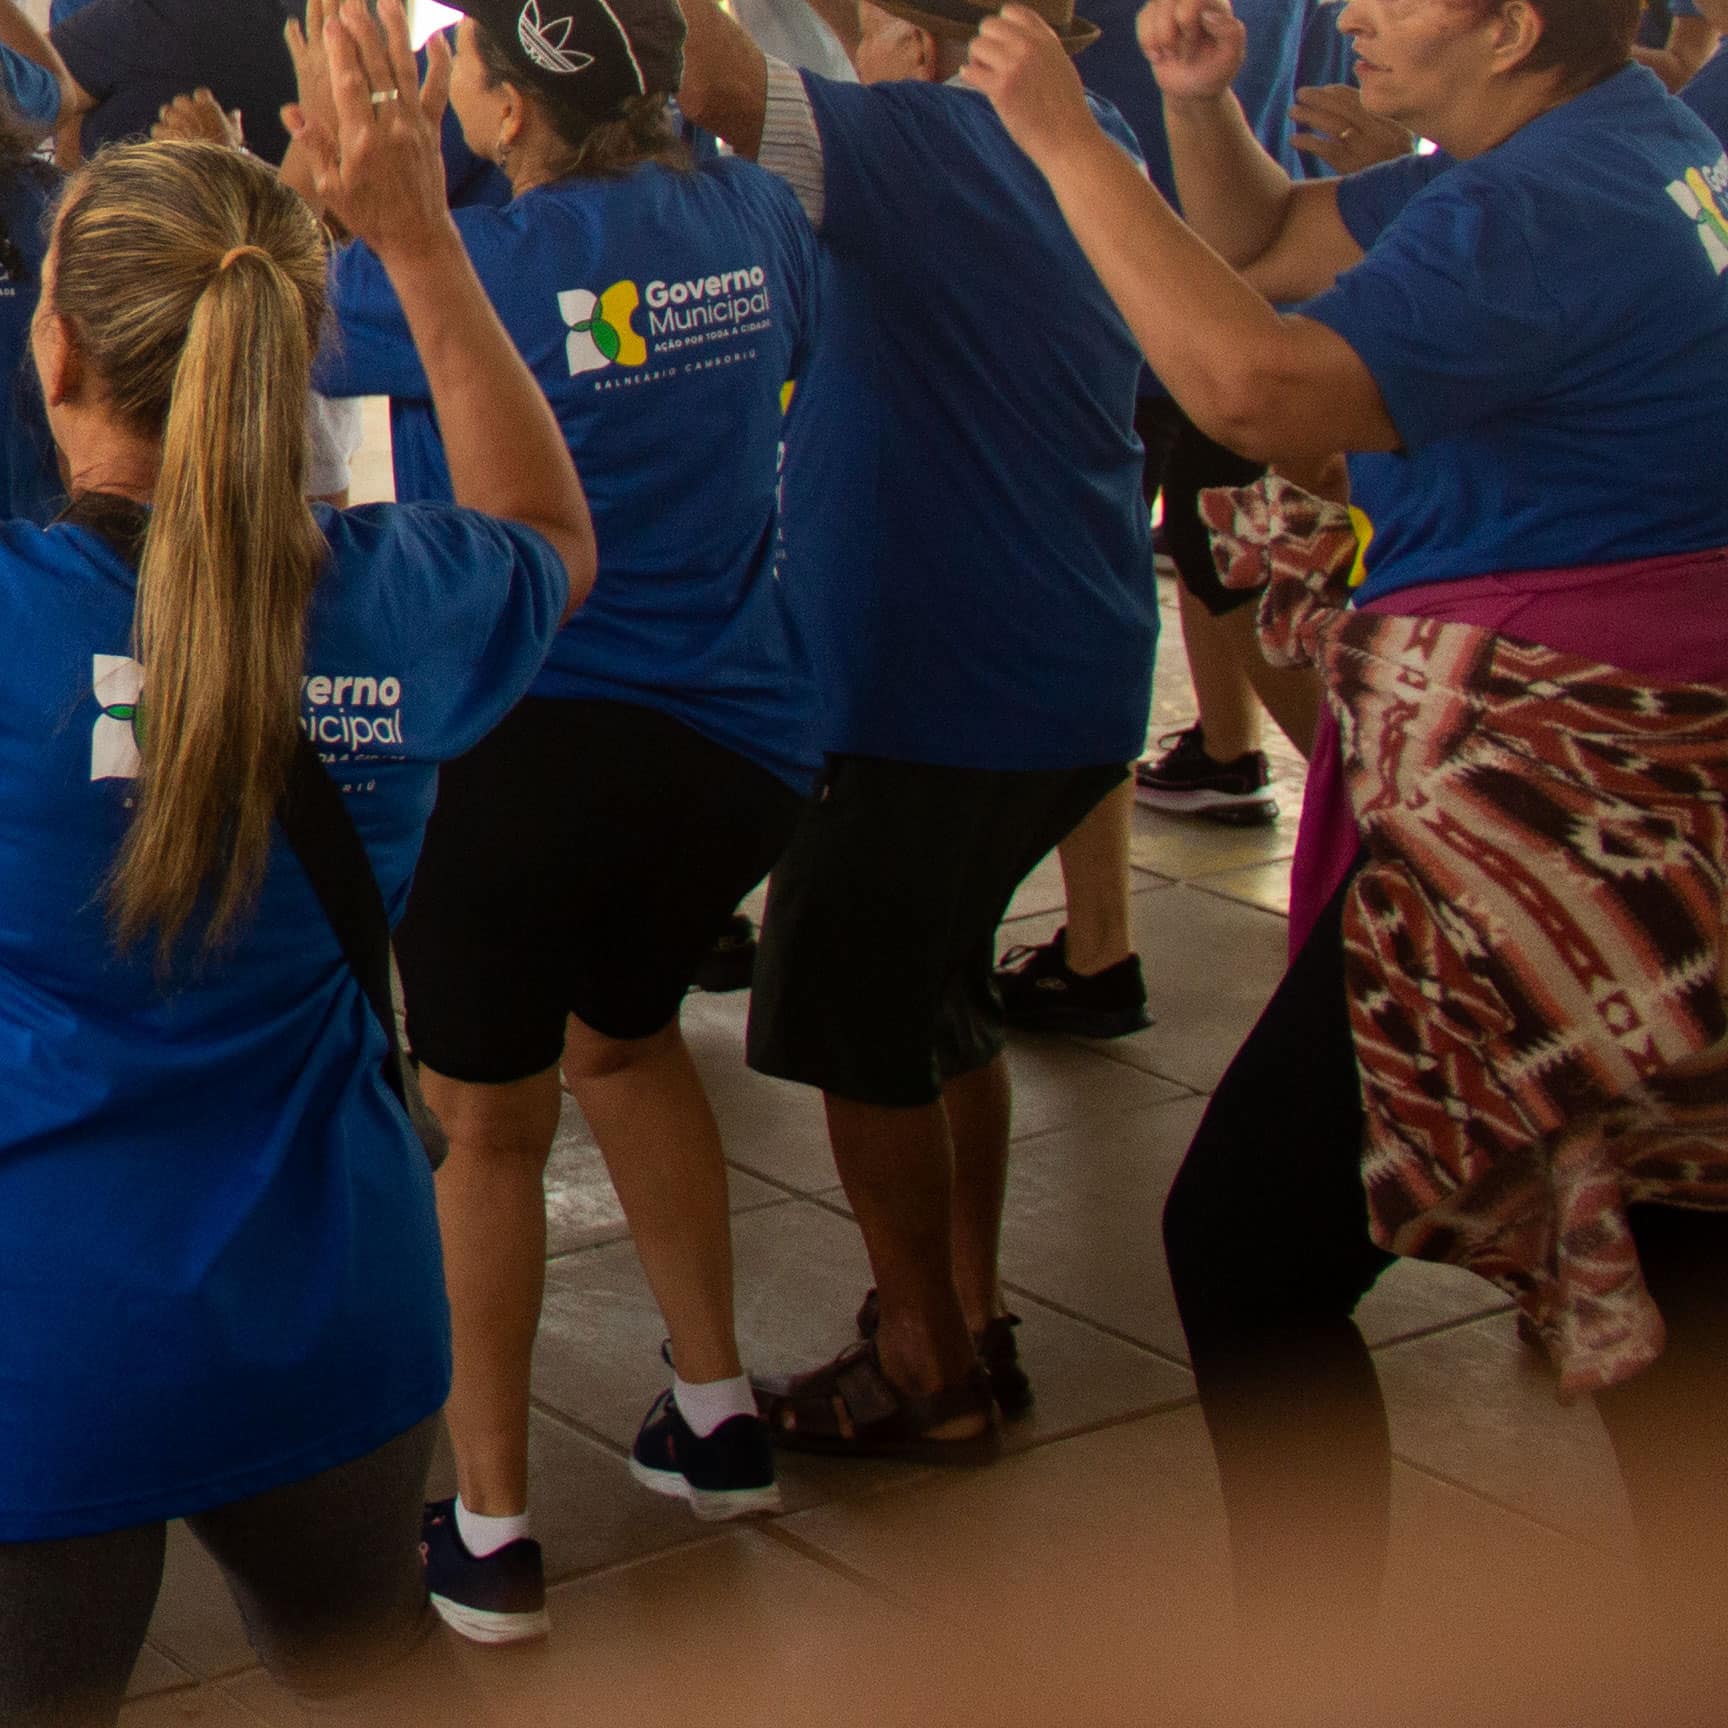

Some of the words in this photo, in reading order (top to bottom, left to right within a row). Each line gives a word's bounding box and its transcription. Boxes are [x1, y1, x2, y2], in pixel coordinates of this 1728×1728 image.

[645, 265, 765, 308] Governo
[648, 287, 770, 336] Municipal
[654, 338, 683, 352] AÇÃO
[684, 334, 704, 346] POR
[706, 329, 730, 341] TODA
[301, 675, 401, 707] erno
[300, 706, 404, 752] icipal
